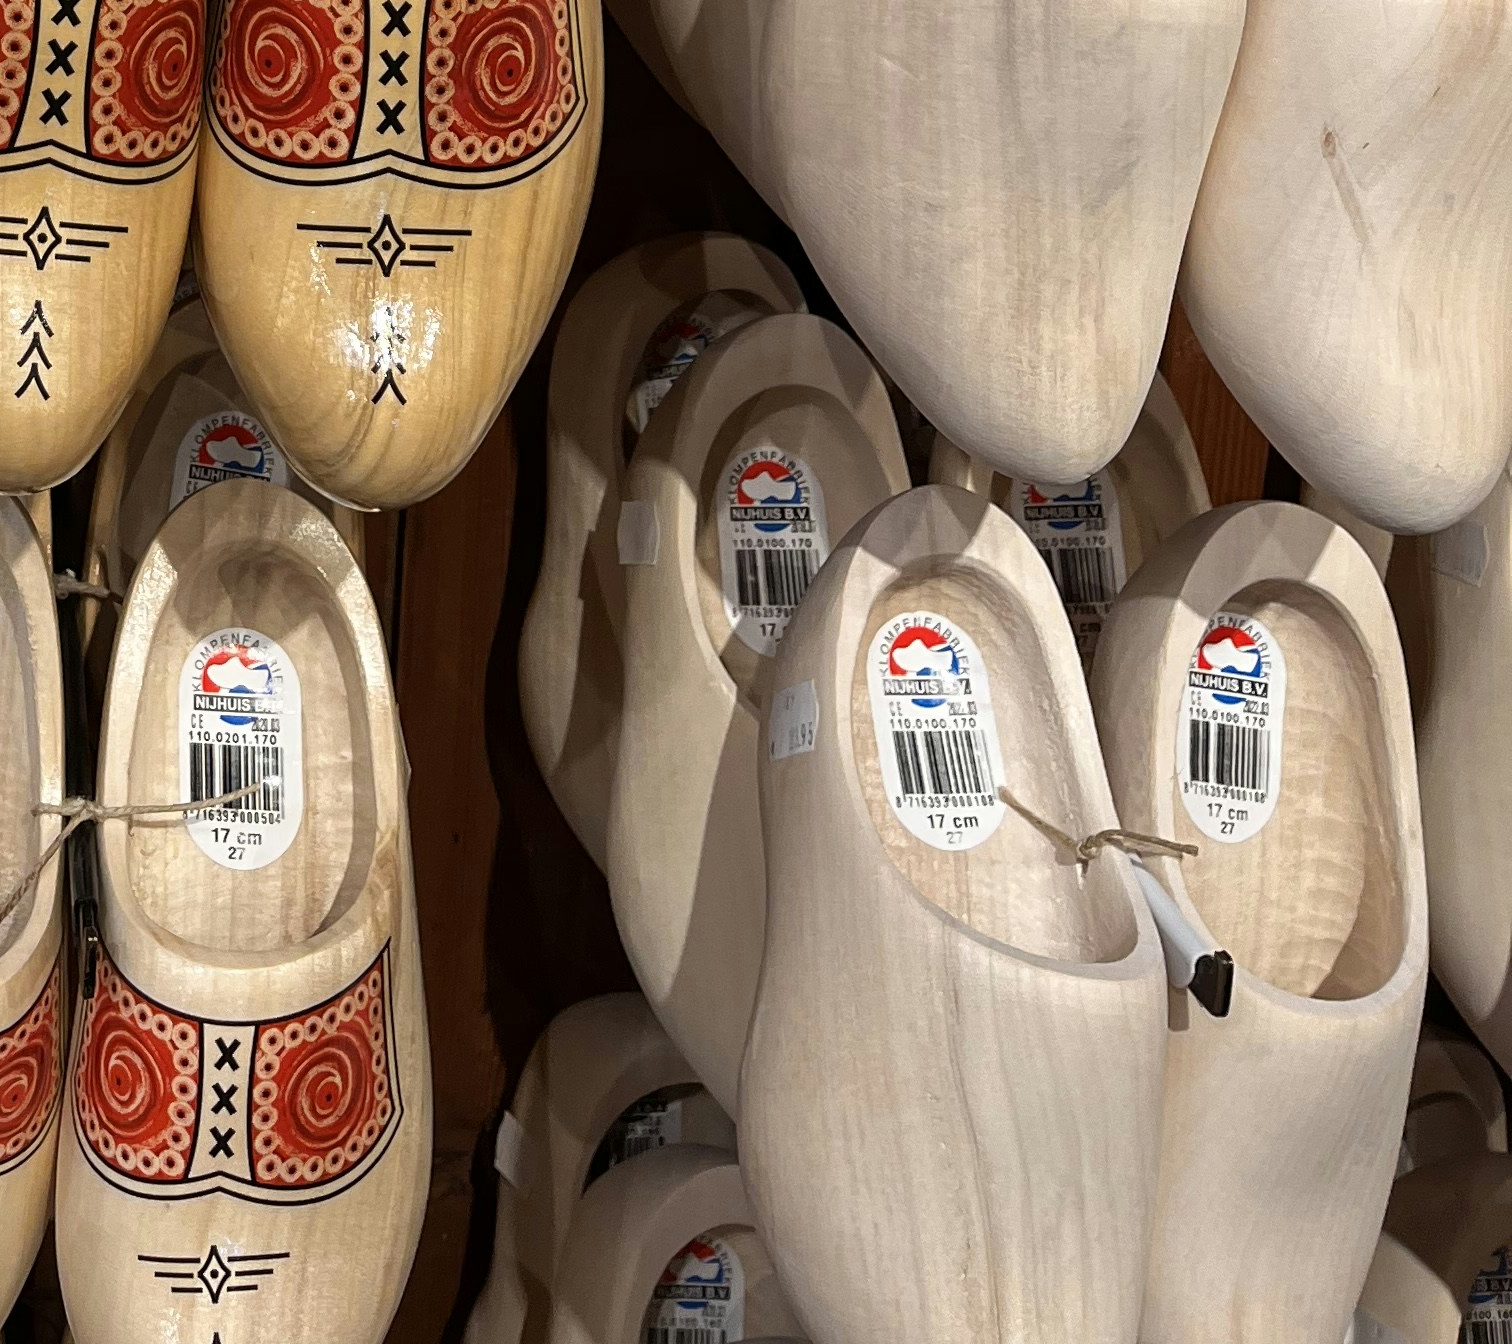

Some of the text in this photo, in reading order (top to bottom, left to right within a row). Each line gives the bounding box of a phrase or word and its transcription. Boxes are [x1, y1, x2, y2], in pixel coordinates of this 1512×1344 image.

[1190, 674, 1266, 697] NIJHUIS B.V.
[196, 696, 250, 711] NIJHUIS
[890, 718, 976, 729] 110.0100.170
[1190, 707, 1265, 727] 110.0100.170
[189, 731, 276, 745] 110.0201.170
[1207, 803, 1247, 820] 17 cm
[927, 814, 978, 828] 17 cm
[1221, 822, 1234, 834] 27
[212, 828, 262, 845] 17 cm
